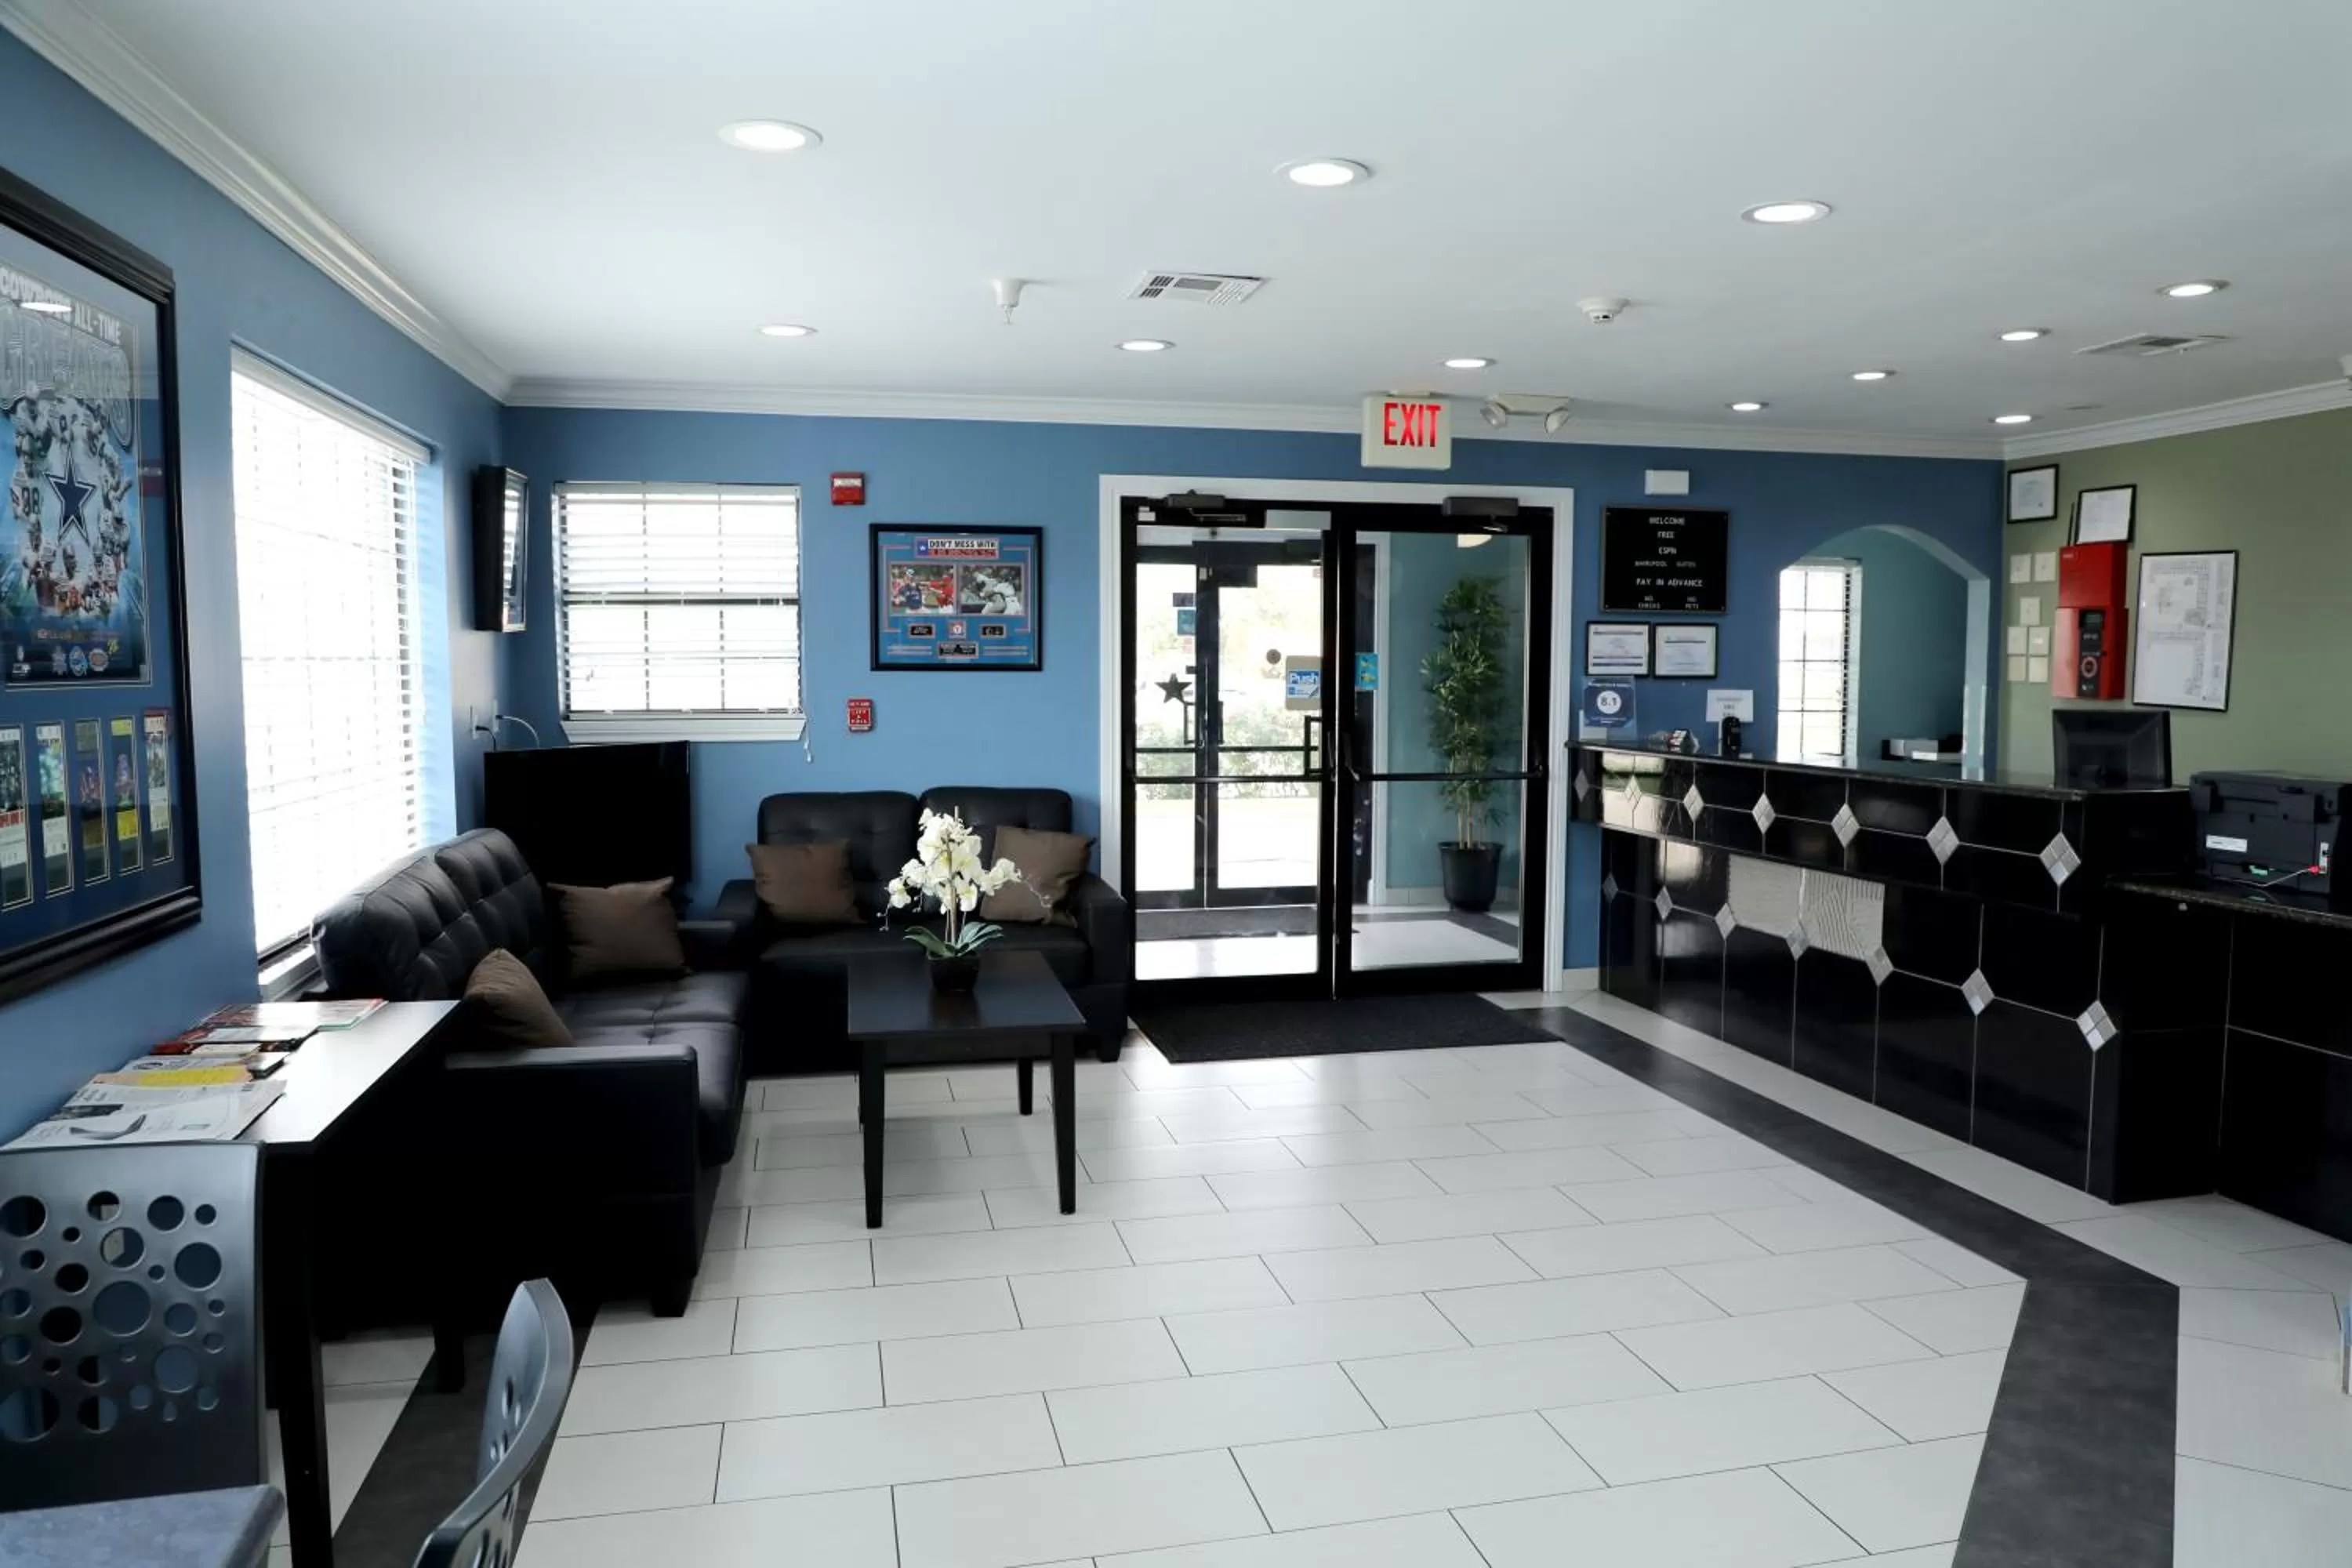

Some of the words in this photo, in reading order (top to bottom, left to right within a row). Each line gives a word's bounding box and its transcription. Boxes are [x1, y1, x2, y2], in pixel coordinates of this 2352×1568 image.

[1384, 402, 1440, 447] EXIT
[1649, 516, 1685, 525] WELCOME
[1668, 579, 1704, 587] ADVANCE
[1290, 672, 1319, 684] Push
